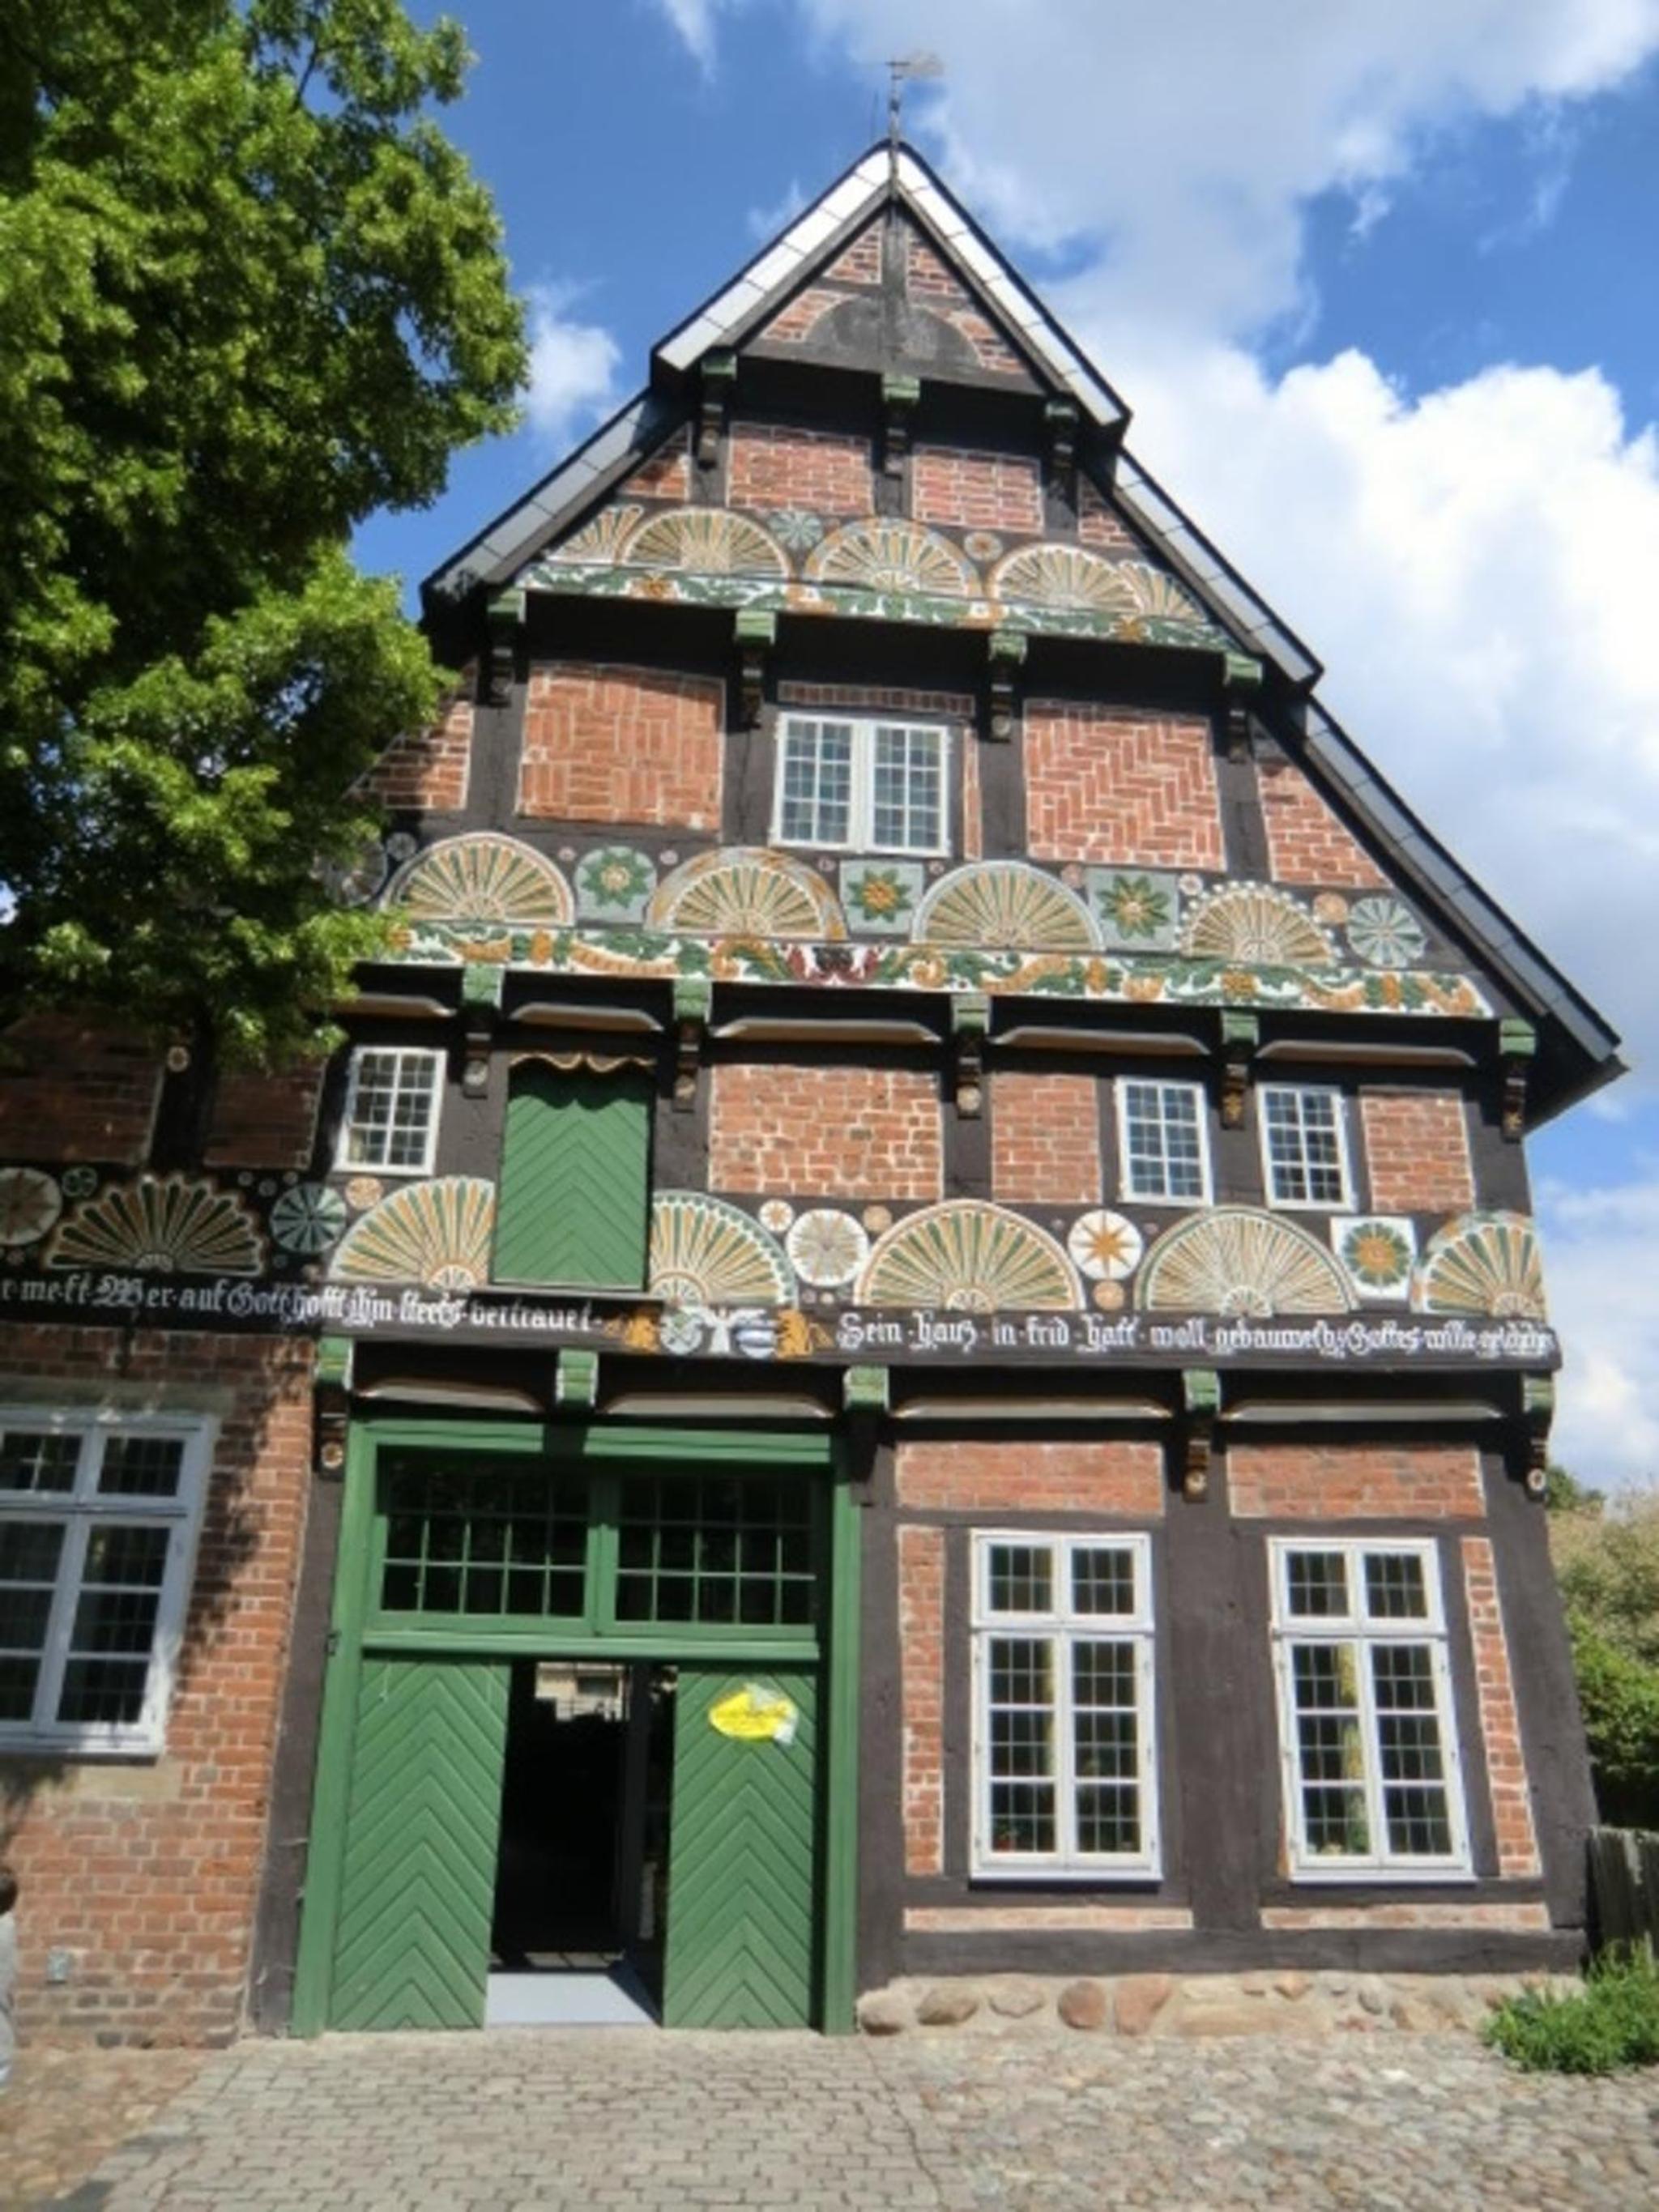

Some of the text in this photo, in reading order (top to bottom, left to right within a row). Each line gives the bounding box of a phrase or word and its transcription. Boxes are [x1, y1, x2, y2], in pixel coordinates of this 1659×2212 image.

[92, 1274, 173, 1310] Wer
[178, 1277, 229, 1312] auf
[227, 1280, 290, 1318] Gott
[837, 1311, 903, 1351] Sein
[992, 1316, 1017, 1346] in
[1026, 1315, 1070, 1346] frid
